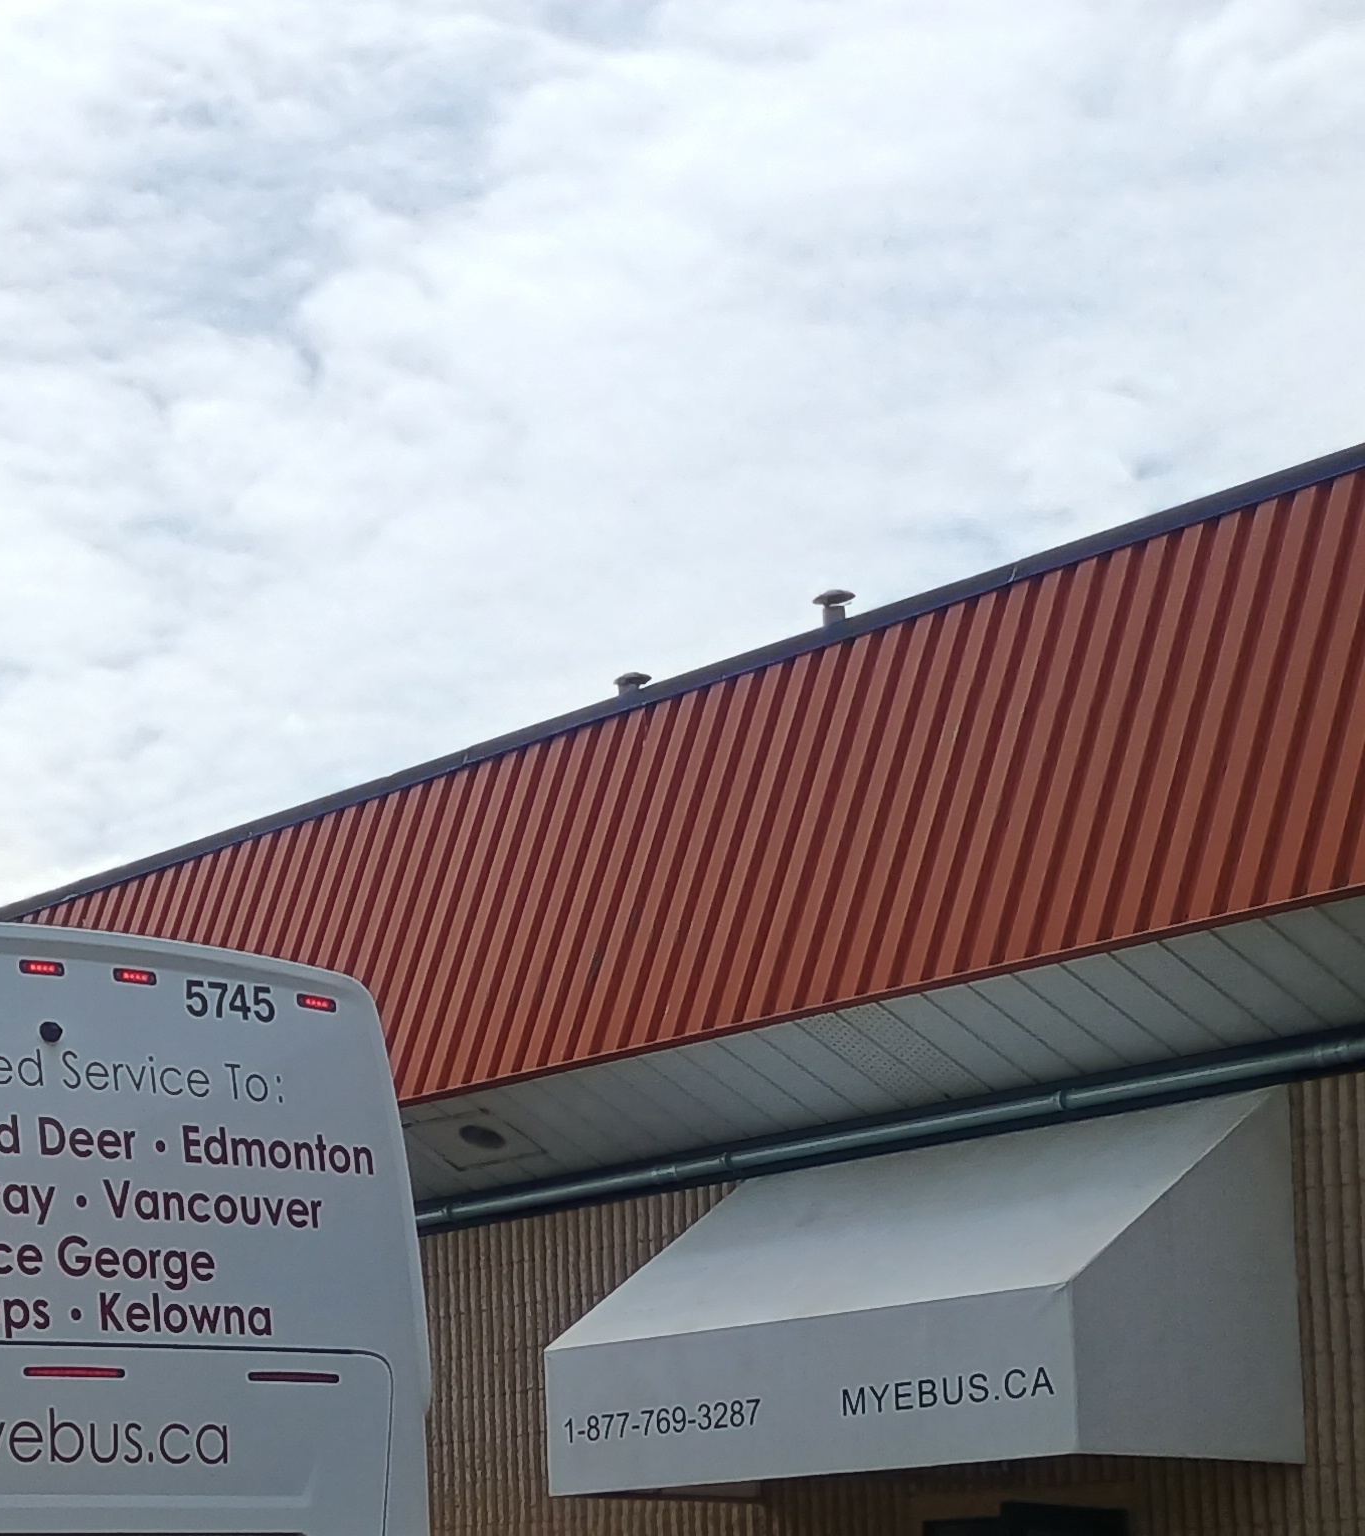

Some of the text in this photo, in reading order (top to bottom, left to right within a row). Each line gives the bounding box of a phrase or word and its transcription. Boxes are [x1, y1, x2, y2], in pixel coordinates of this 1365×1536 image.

[185, 979, 276, 1023] 5745
[61, 1050, 210, 1098] Service
[224, 1063, 284, 1104] To:
[37, 1116, 136, 1160] Deer
[182, 1124, 374, 1176] Edmonton
[102, 1179, 322, 1229] Vancouver
[57, 1235, 215, 1291] George
[99, 1292, 272, 1337] Kelowna
[564, 1366, 1055, 1444] 1-877-769-3287 MYEBUS.CA
